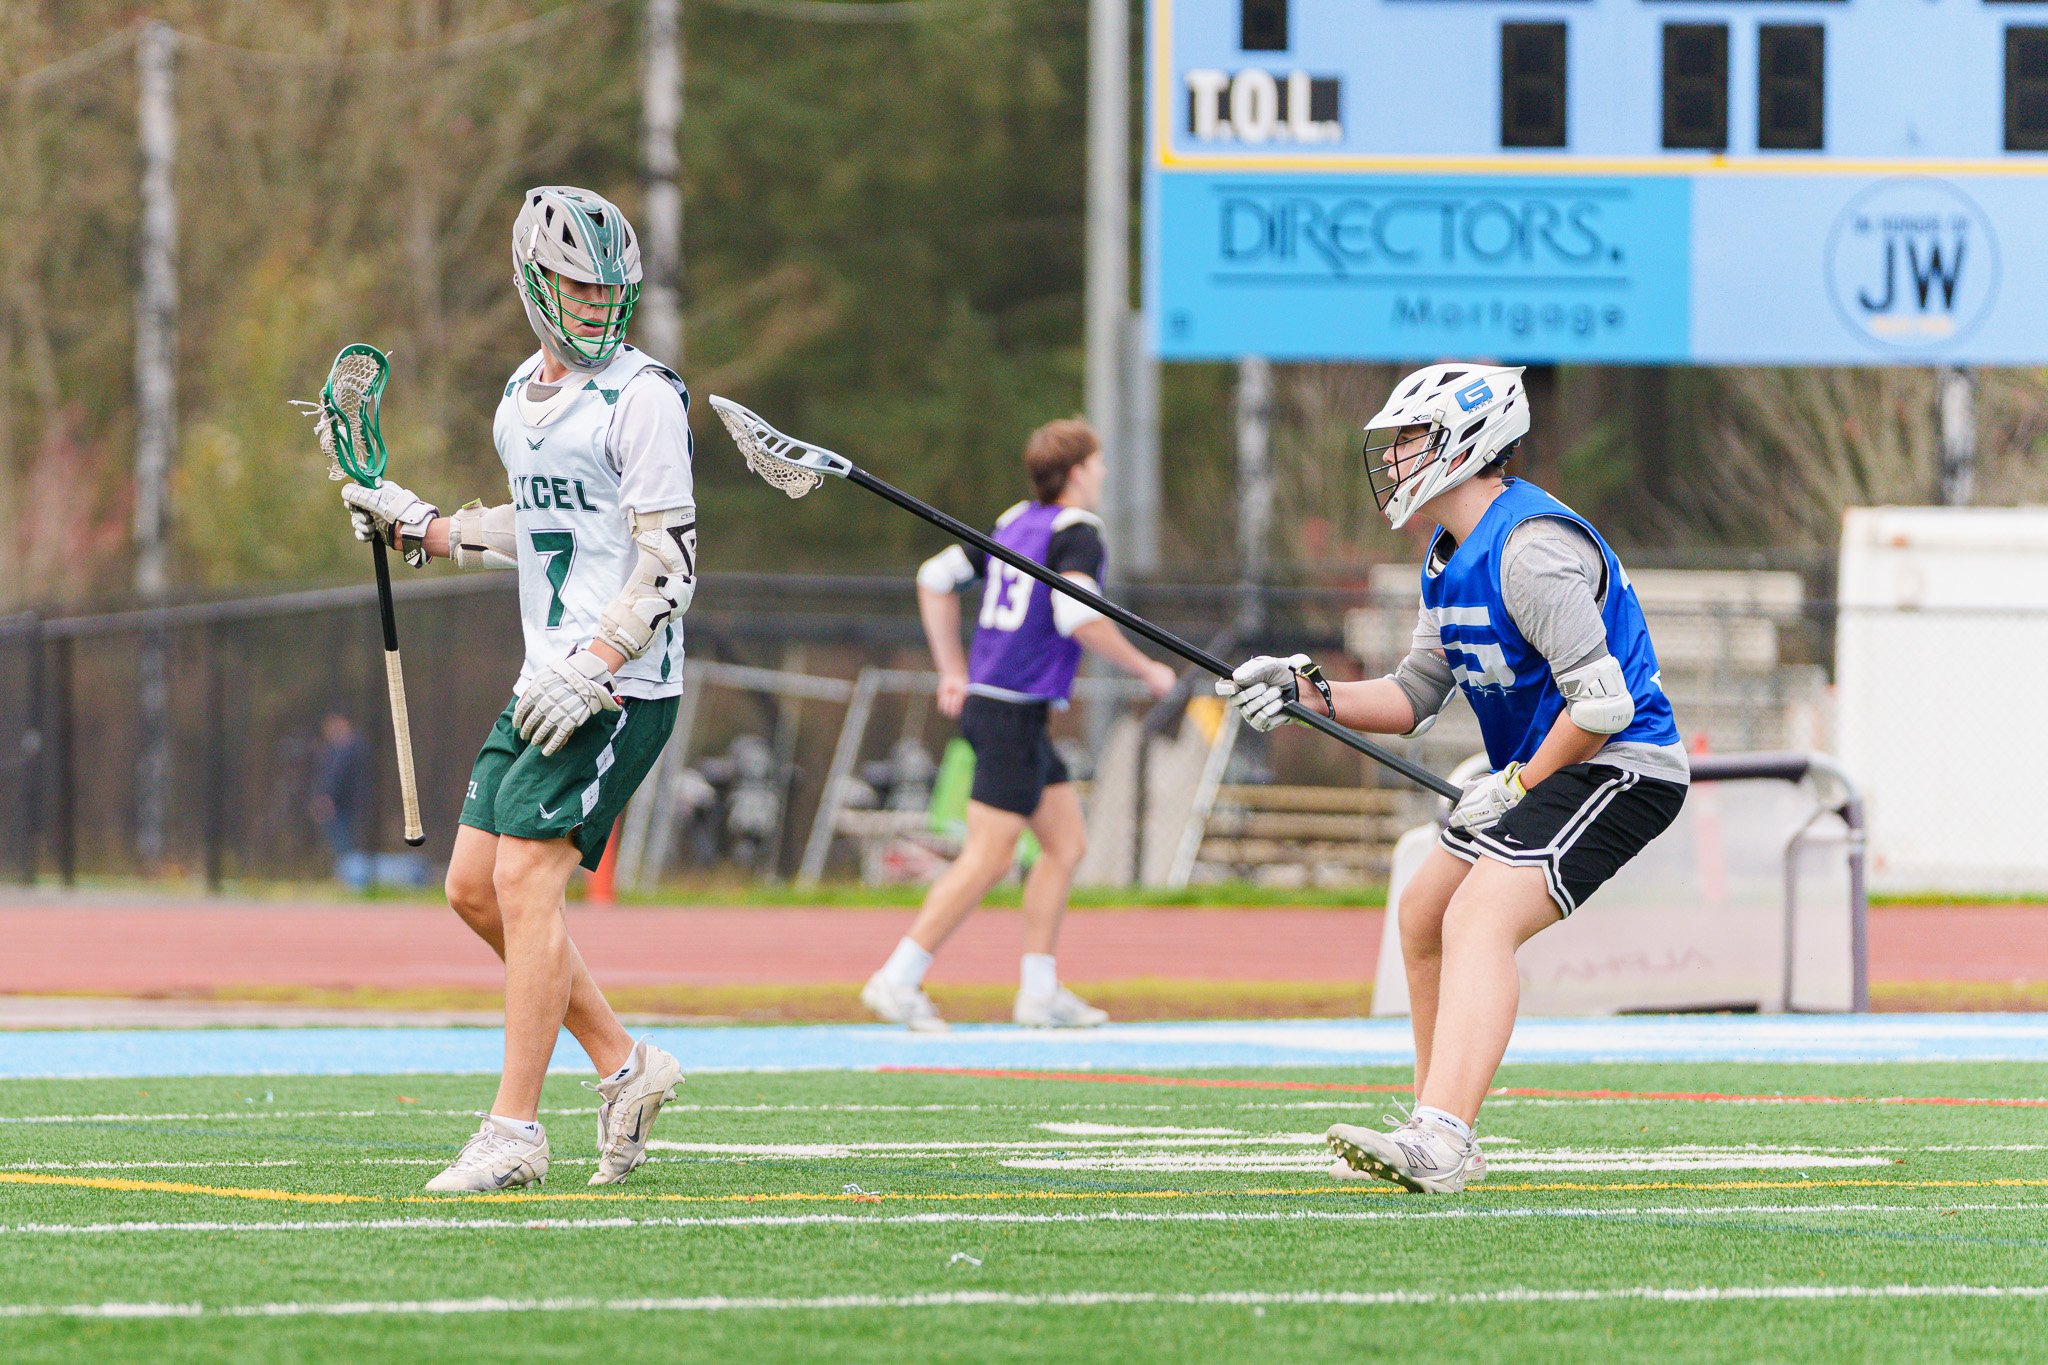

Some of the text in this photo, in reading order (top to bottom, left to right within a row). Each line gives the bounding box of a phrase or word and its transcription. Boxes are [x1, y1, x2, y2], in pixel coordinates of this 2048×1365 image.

[1185, 69, 1343, 142] T.O.L.
[1857, 237, 1968, 312] JW
[1391, 296, 1625, 338] Mortgage
[1454, 378, 1494, 412] G
[405, 548, 418, 560] RZR
[529, 528, 578, 630] 7
[978, 554, 1036, 632] 13
